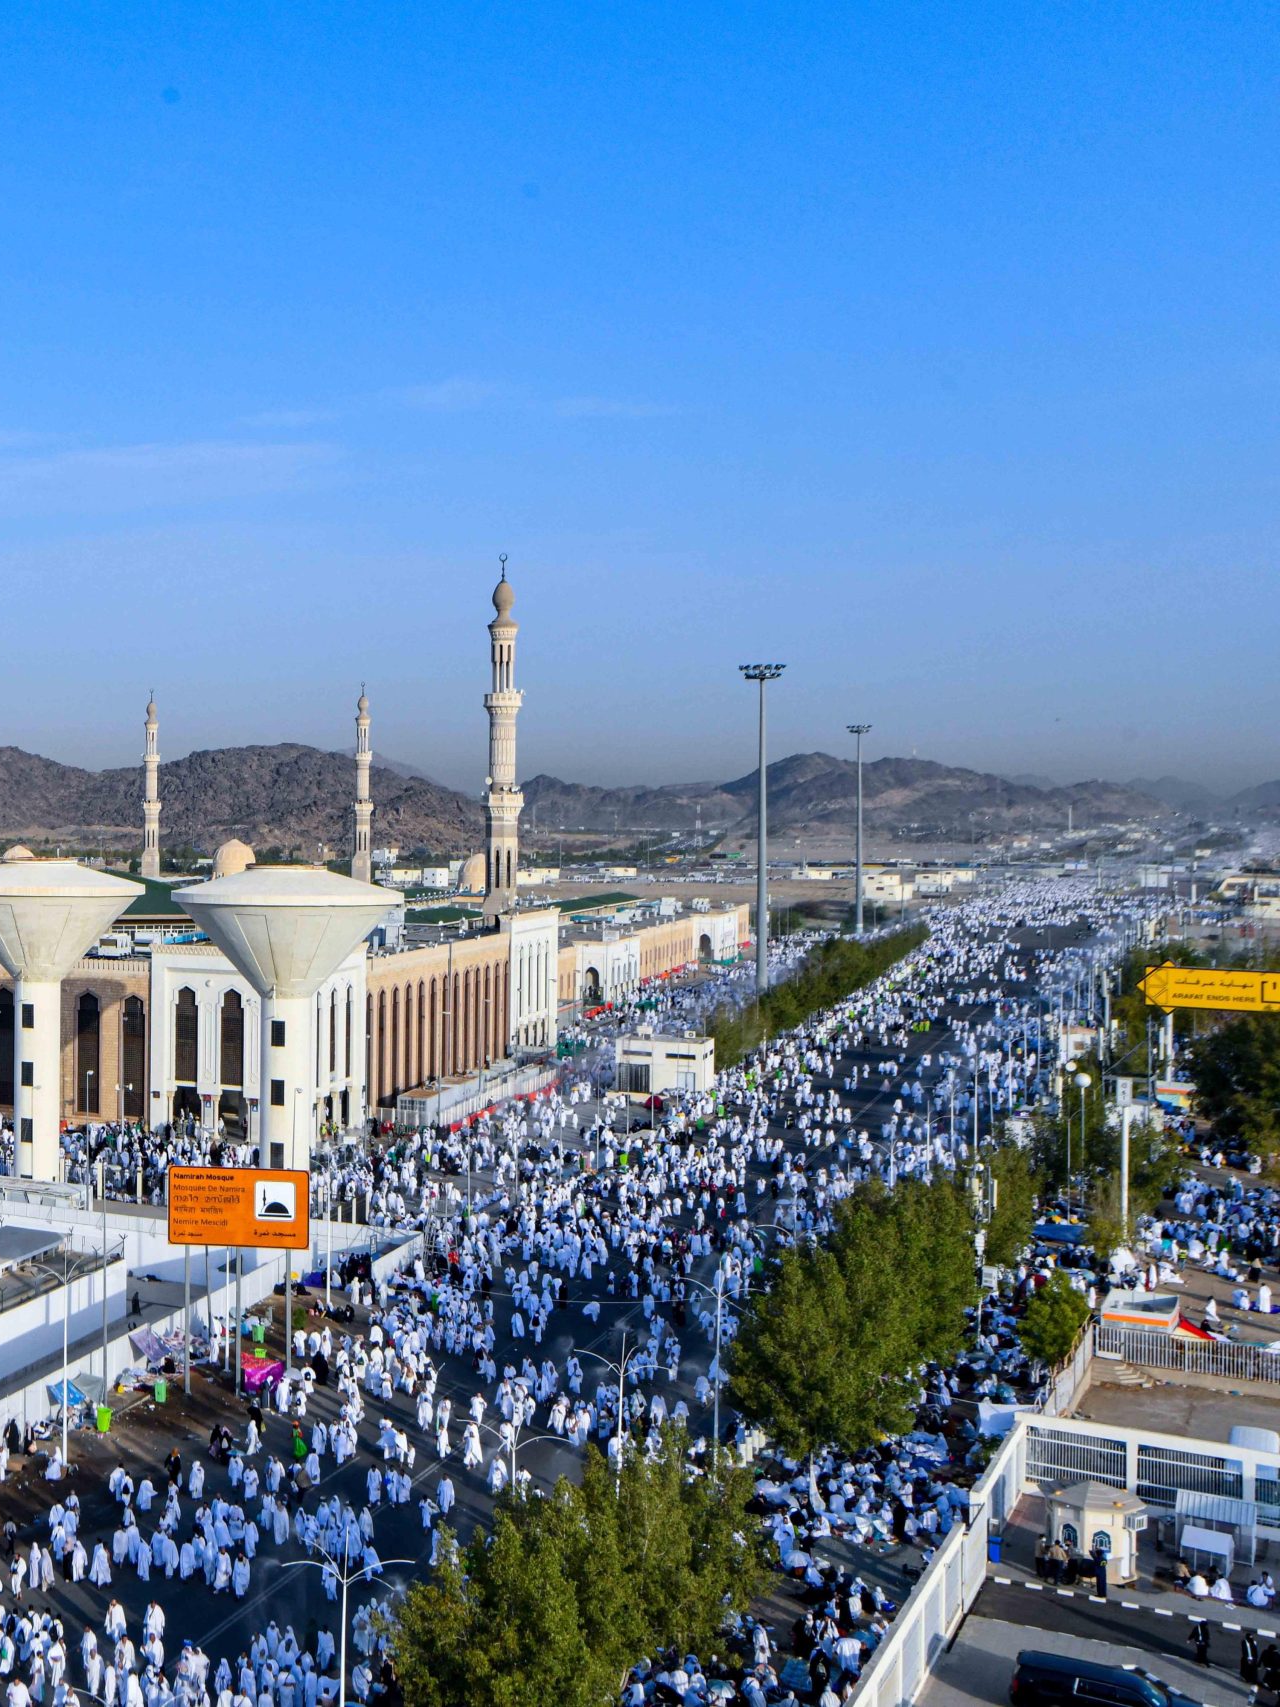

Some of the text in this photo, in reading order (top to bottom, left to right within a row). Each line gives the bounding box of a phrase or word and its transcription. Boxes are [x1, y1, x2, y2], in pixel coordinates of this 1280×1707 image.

[1174, 977, 1254, 989] نهاية عرفات
[1172, 992, 1204, 1000] ARAFAT
[1206, 994, 1231, 1002] ENDS
[208, 1184, 218, 1192] De
[220, 1185, 246, 1193] Namira
[173, 1218, 199, 1226] Nemire
[271, 1231, 297, 1239] مسجد
